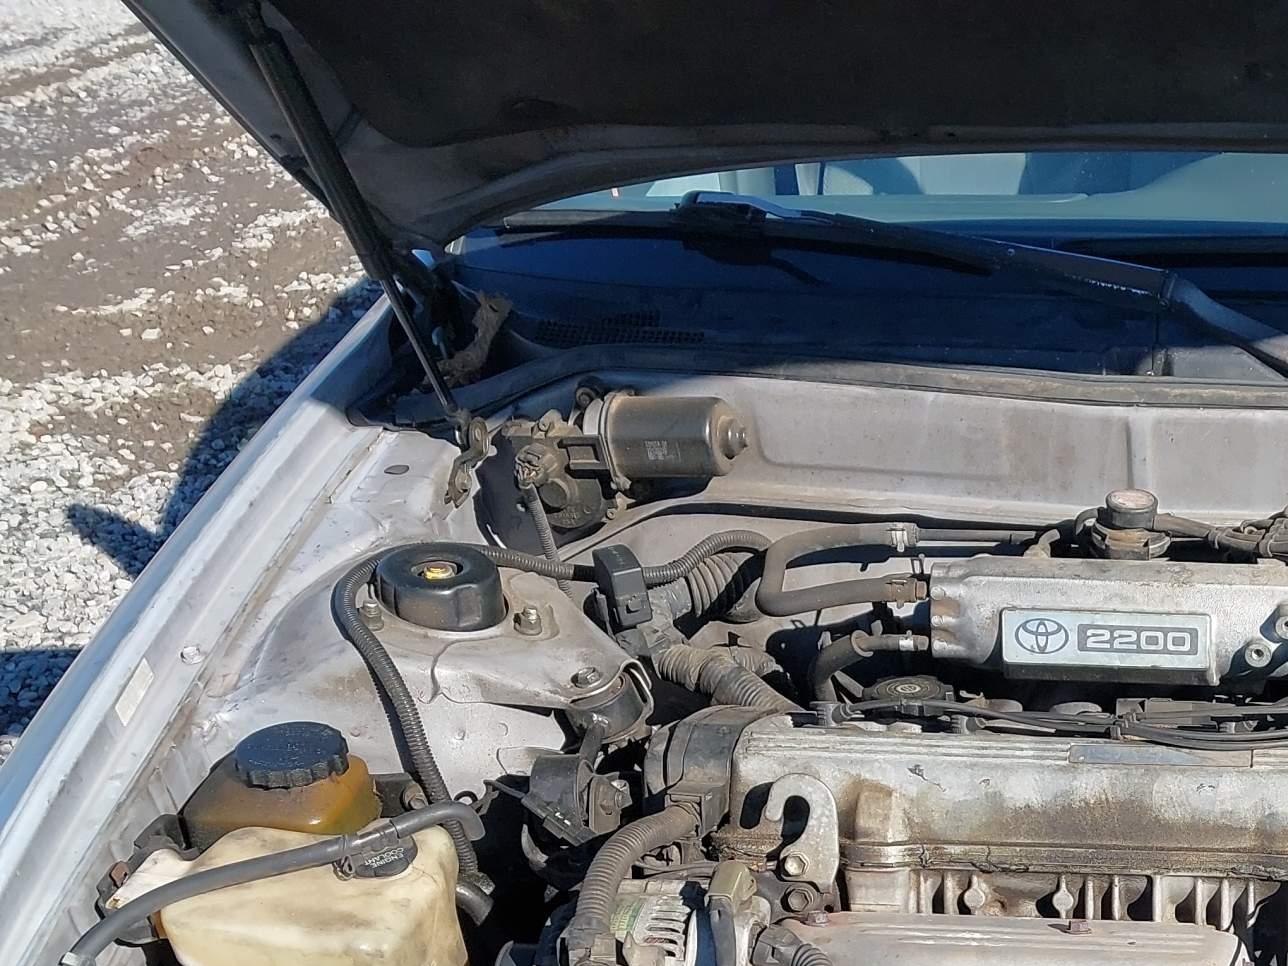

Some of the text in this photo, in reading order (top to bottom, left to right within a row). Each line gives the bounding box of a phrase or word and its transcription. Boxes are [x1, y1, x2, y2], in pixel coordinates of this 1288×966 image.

[1085, 628, 1191, 652] 2200
[364, 847, 404, 866] COOLANT
[371, 852, 404, 869] ENGINE
